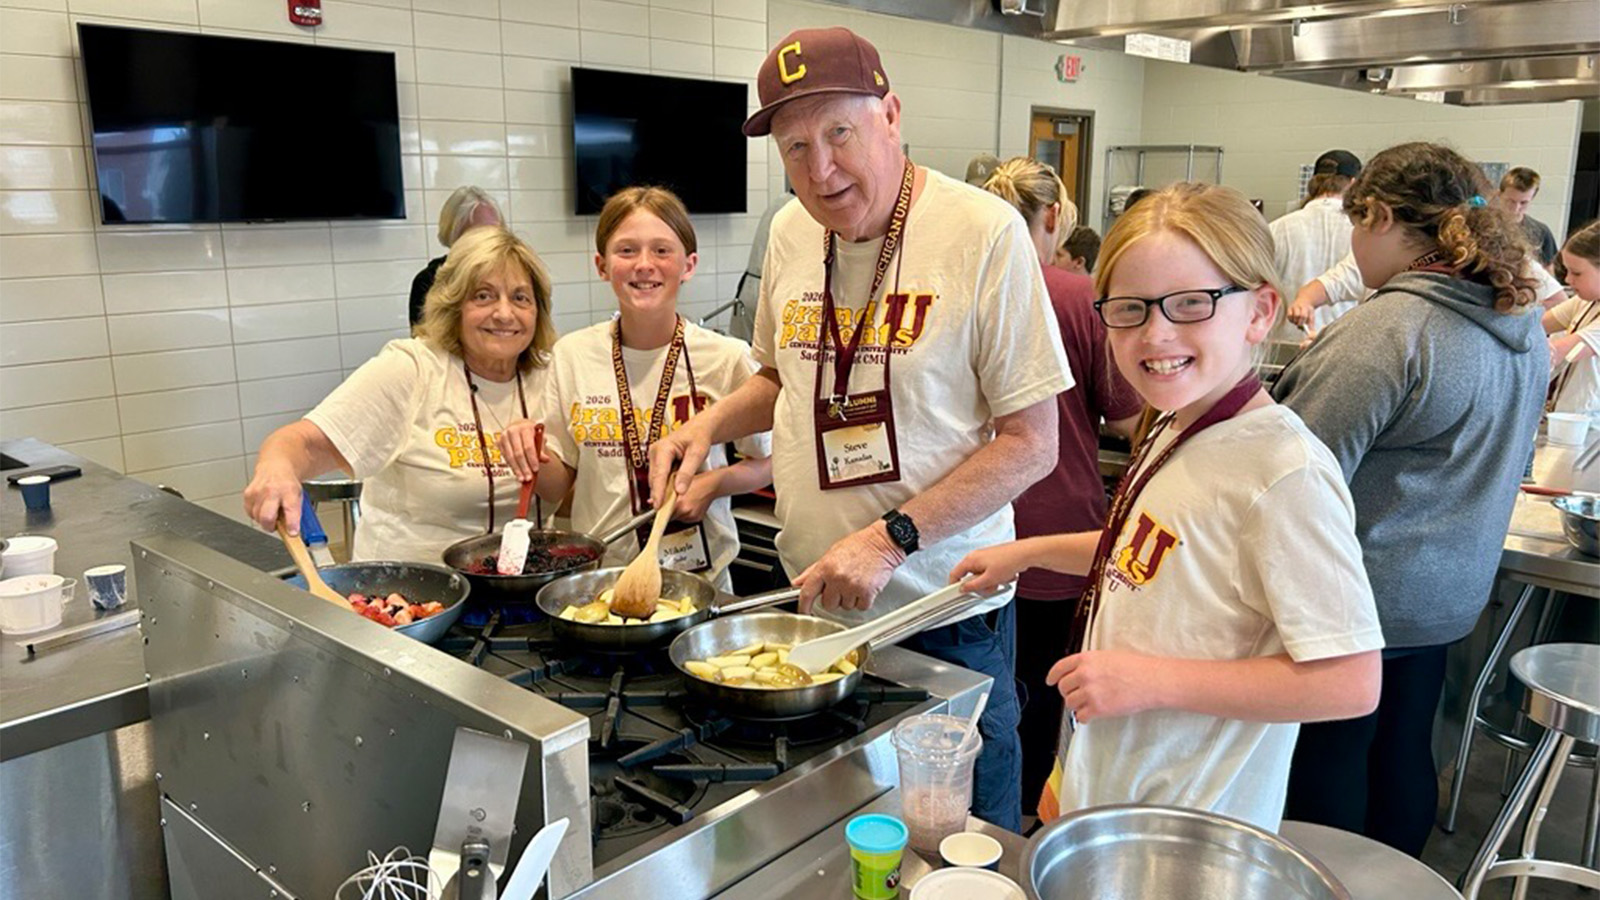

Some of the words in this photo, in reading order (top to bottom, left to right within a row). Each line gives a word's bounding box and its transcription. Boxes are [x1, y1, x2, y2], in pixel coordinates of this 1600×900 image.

[777, 41, 807, 85] C
[1065, 55, 1081, 79] EXIT
[886, 294, 932, 342] U
[586, 396, 611, 404] 2026
[458, 422, 476, 432] 202
[597, 448, 623, 458] Sadd
[843, 442, 868, 453] Steve
